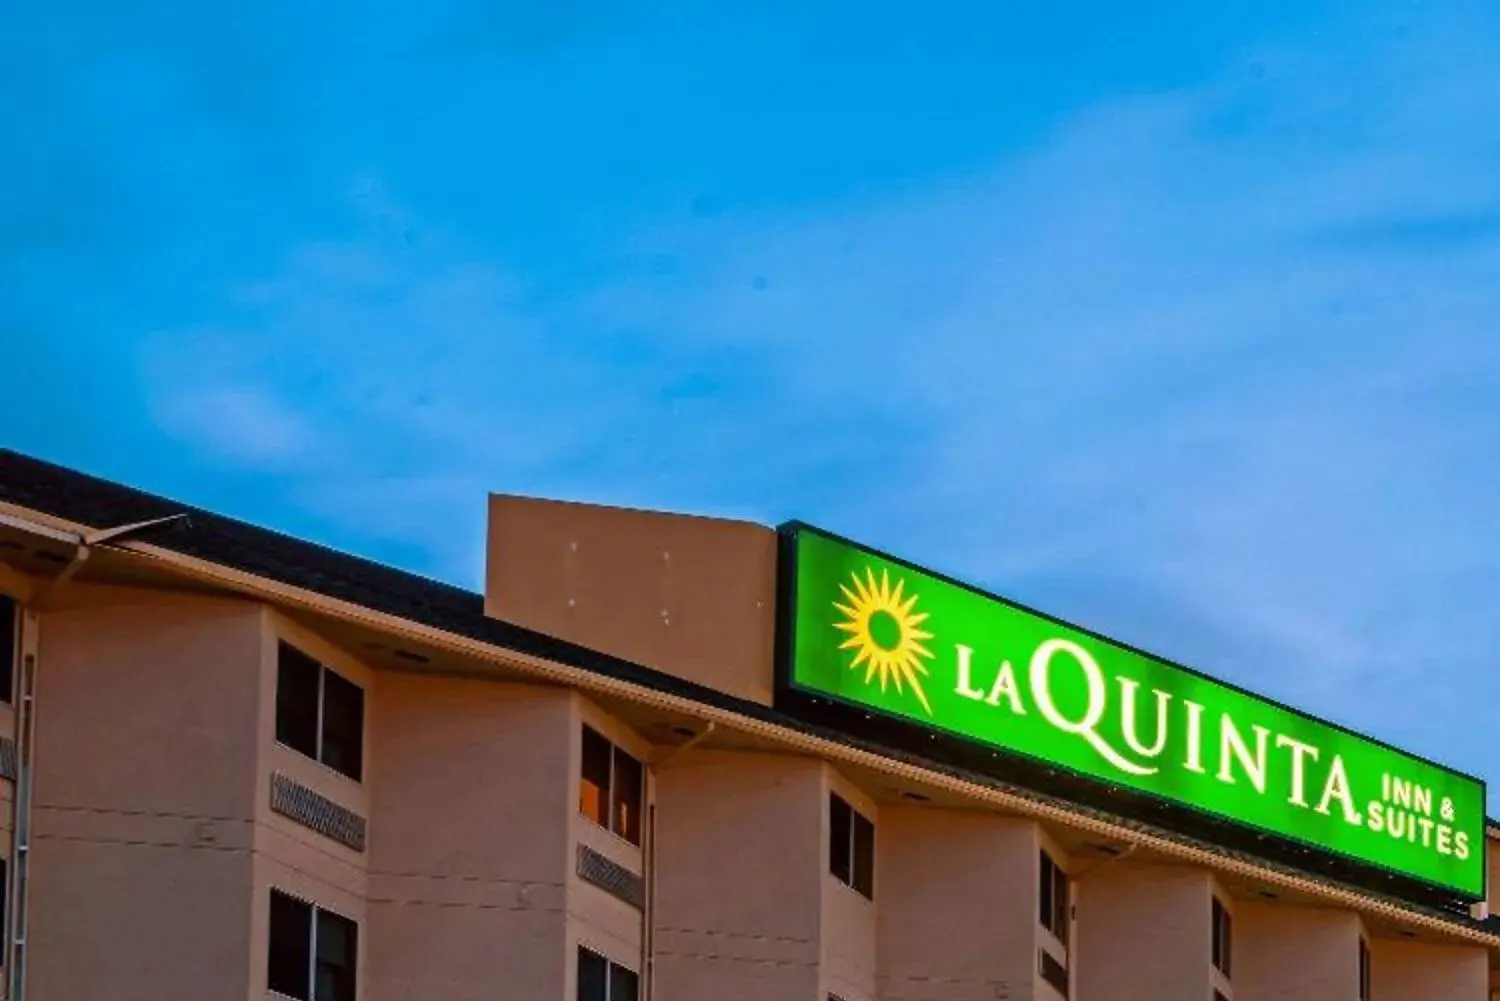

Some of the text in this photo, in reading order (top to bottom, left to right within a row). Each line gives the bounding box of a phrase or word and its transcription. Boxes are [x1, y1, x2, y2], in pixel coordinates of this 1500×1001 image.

[954, 638, 1363, 826] LA QUINTA
[1382, 772, 1455, 822] INN &
[1367, 800, 1470, 861] SUITES
